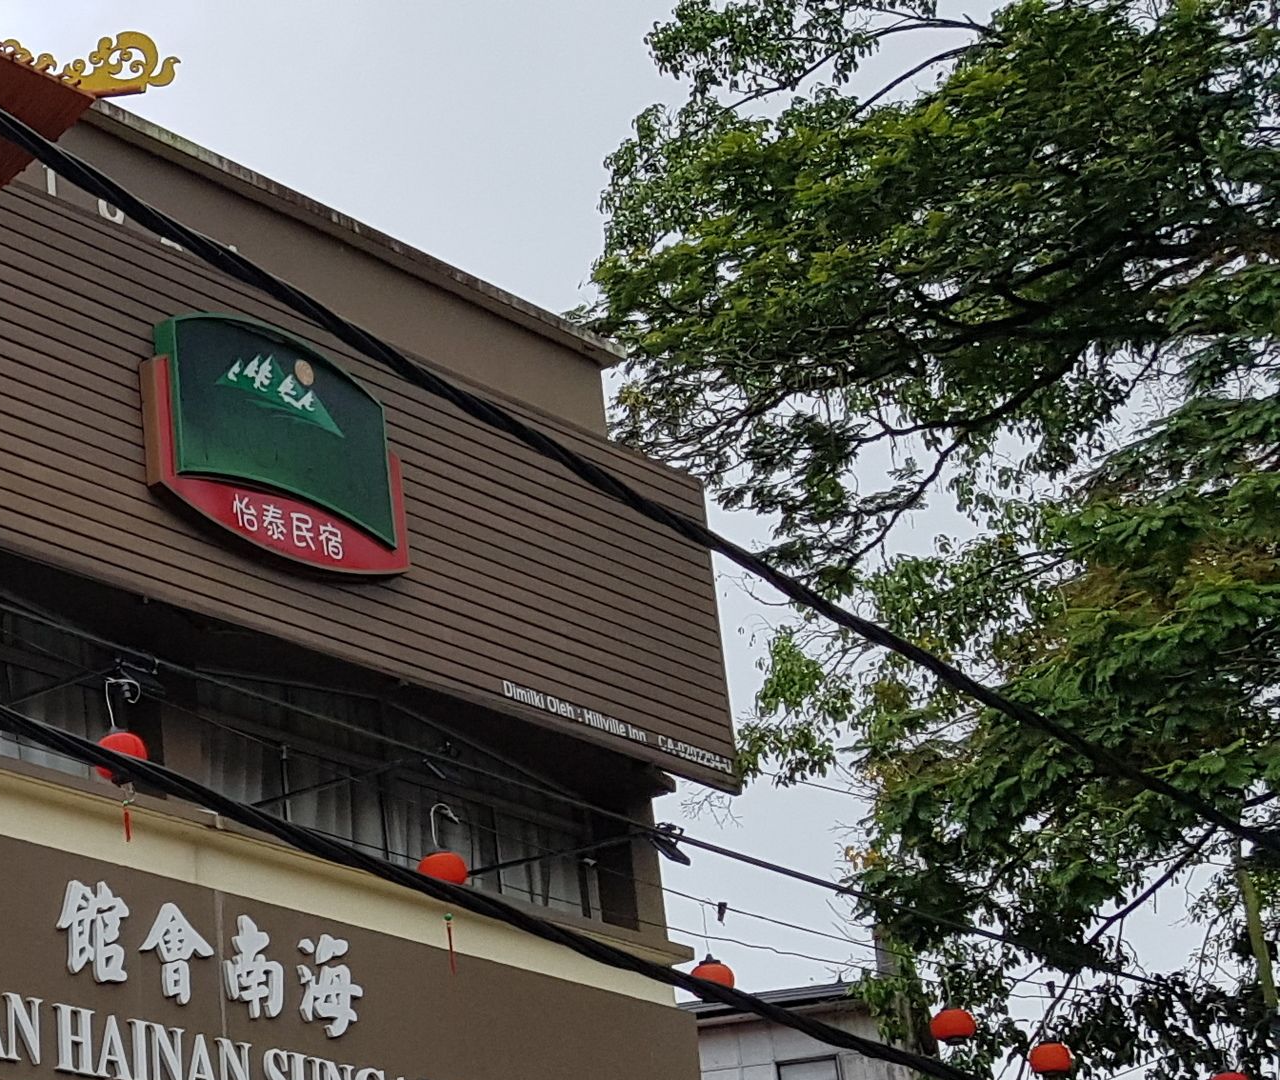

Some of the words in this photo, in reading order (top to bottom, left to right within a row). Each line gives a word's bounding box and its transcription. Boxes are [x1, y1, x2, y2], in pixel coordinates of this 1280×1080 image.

[233, 493, 344, 560] 怡泰民宿
[547, 696, 575, 721] Oleh
[585, 708, 627, 738] Hillville
[628, 724, 648, 744] Inn
